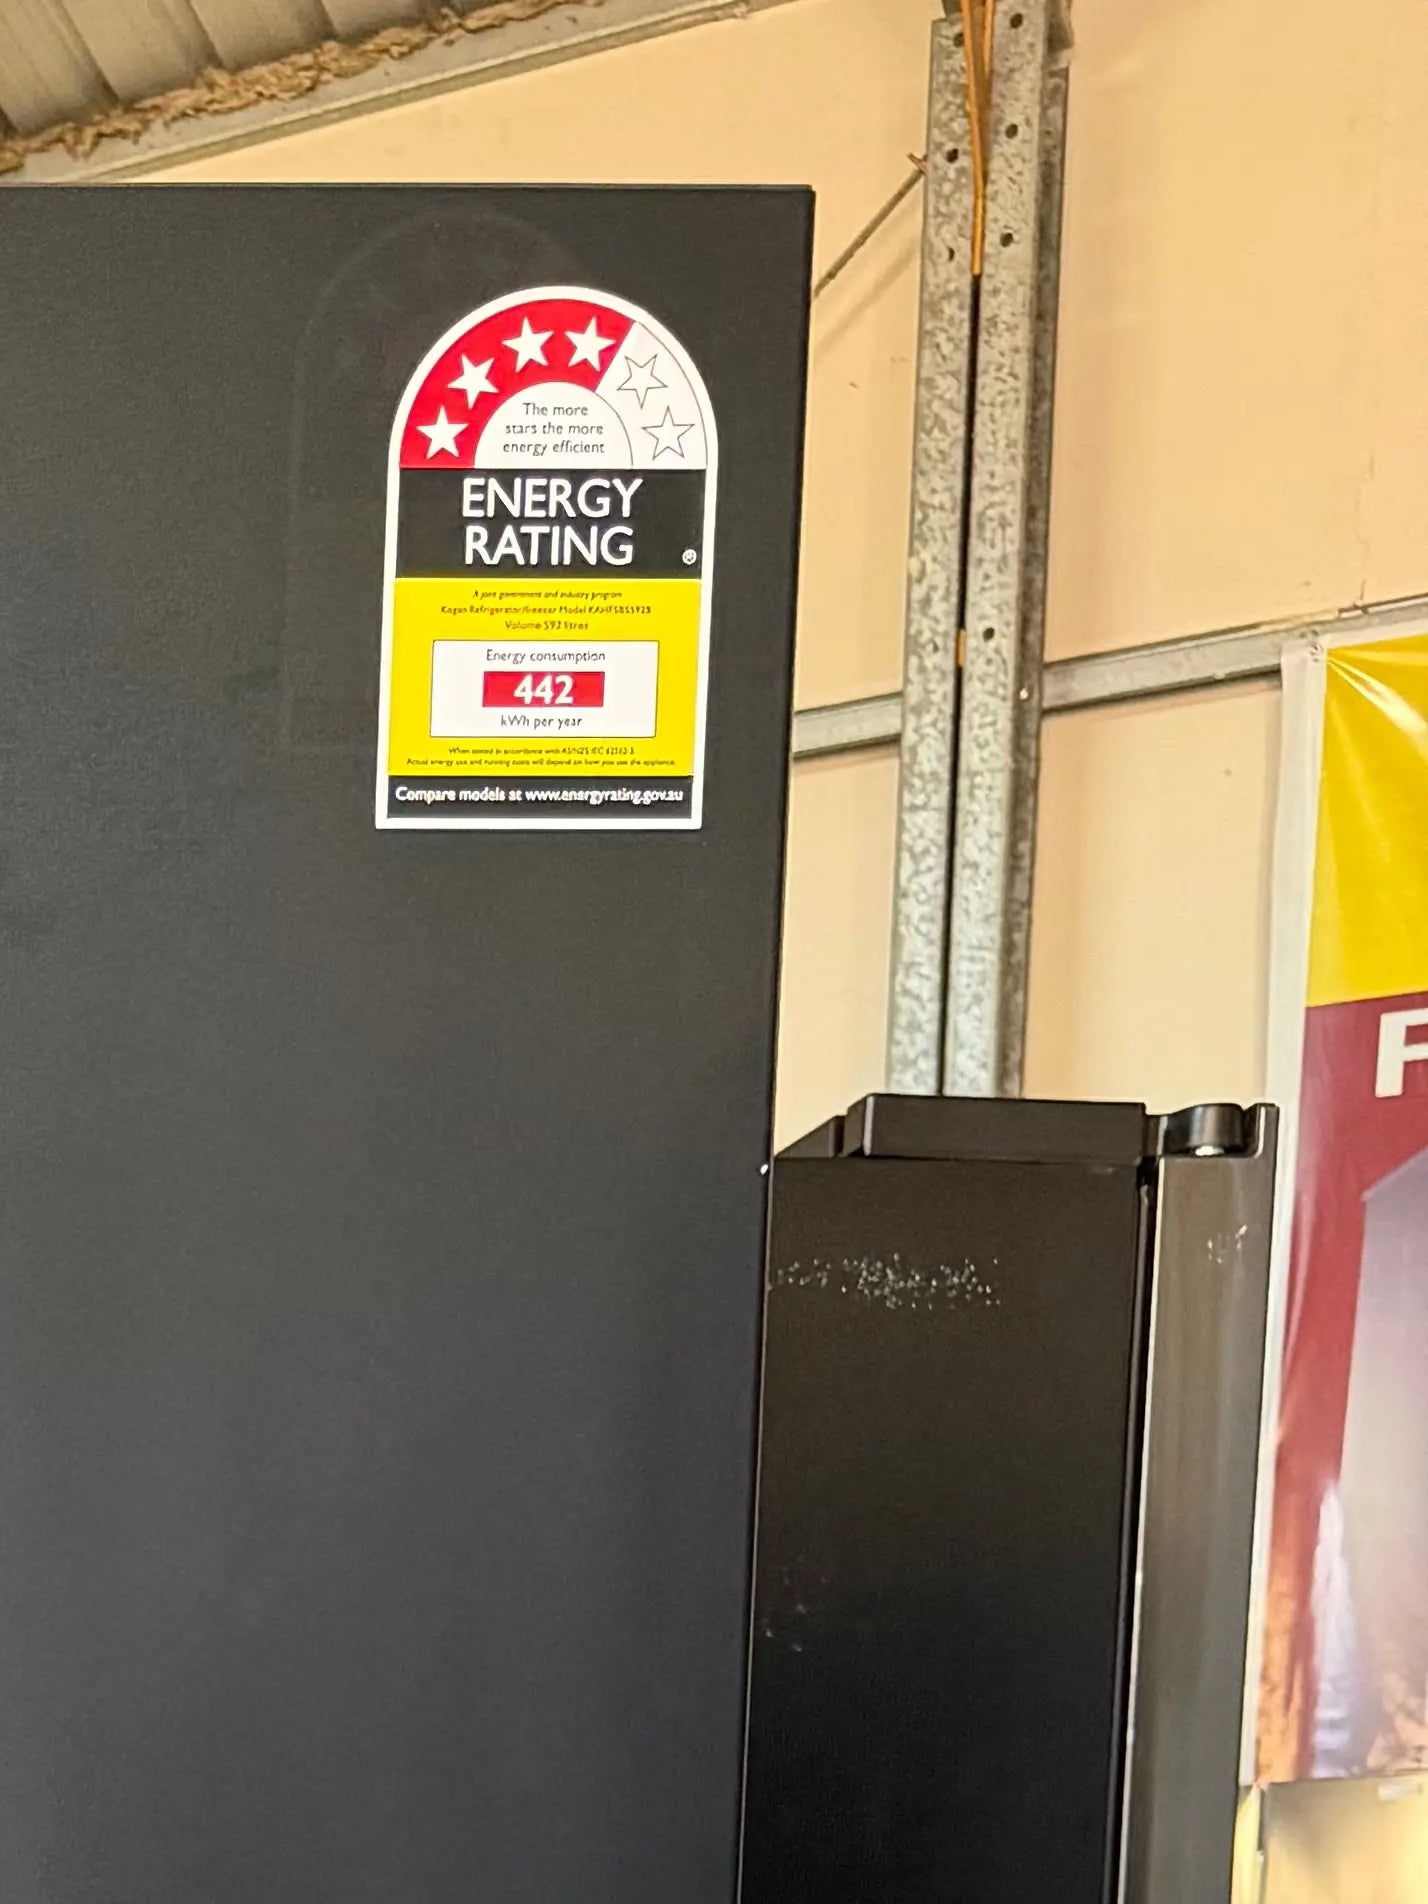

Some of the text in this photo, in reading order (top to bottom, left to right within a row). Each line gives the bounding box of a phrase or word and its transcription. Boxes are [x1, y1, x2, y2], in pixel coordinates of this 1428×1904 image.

[522, 402, 589, 416] The more
[505, 421, 604, 435] stars the more
[502, 439, 605, 456] energy efficient
[461, 477, 644, 518] ENERGY
[464, 525, 634, 566] RATING
[544, 620, 562, 630] 592
[486, 648, 606, 664] Energy consumption
[512, 673, 574, 705] 442
[500, 714, 583, 730] kWh per year
[395, 786, 684, 805] Compare models at www.energyrating.gov.au
